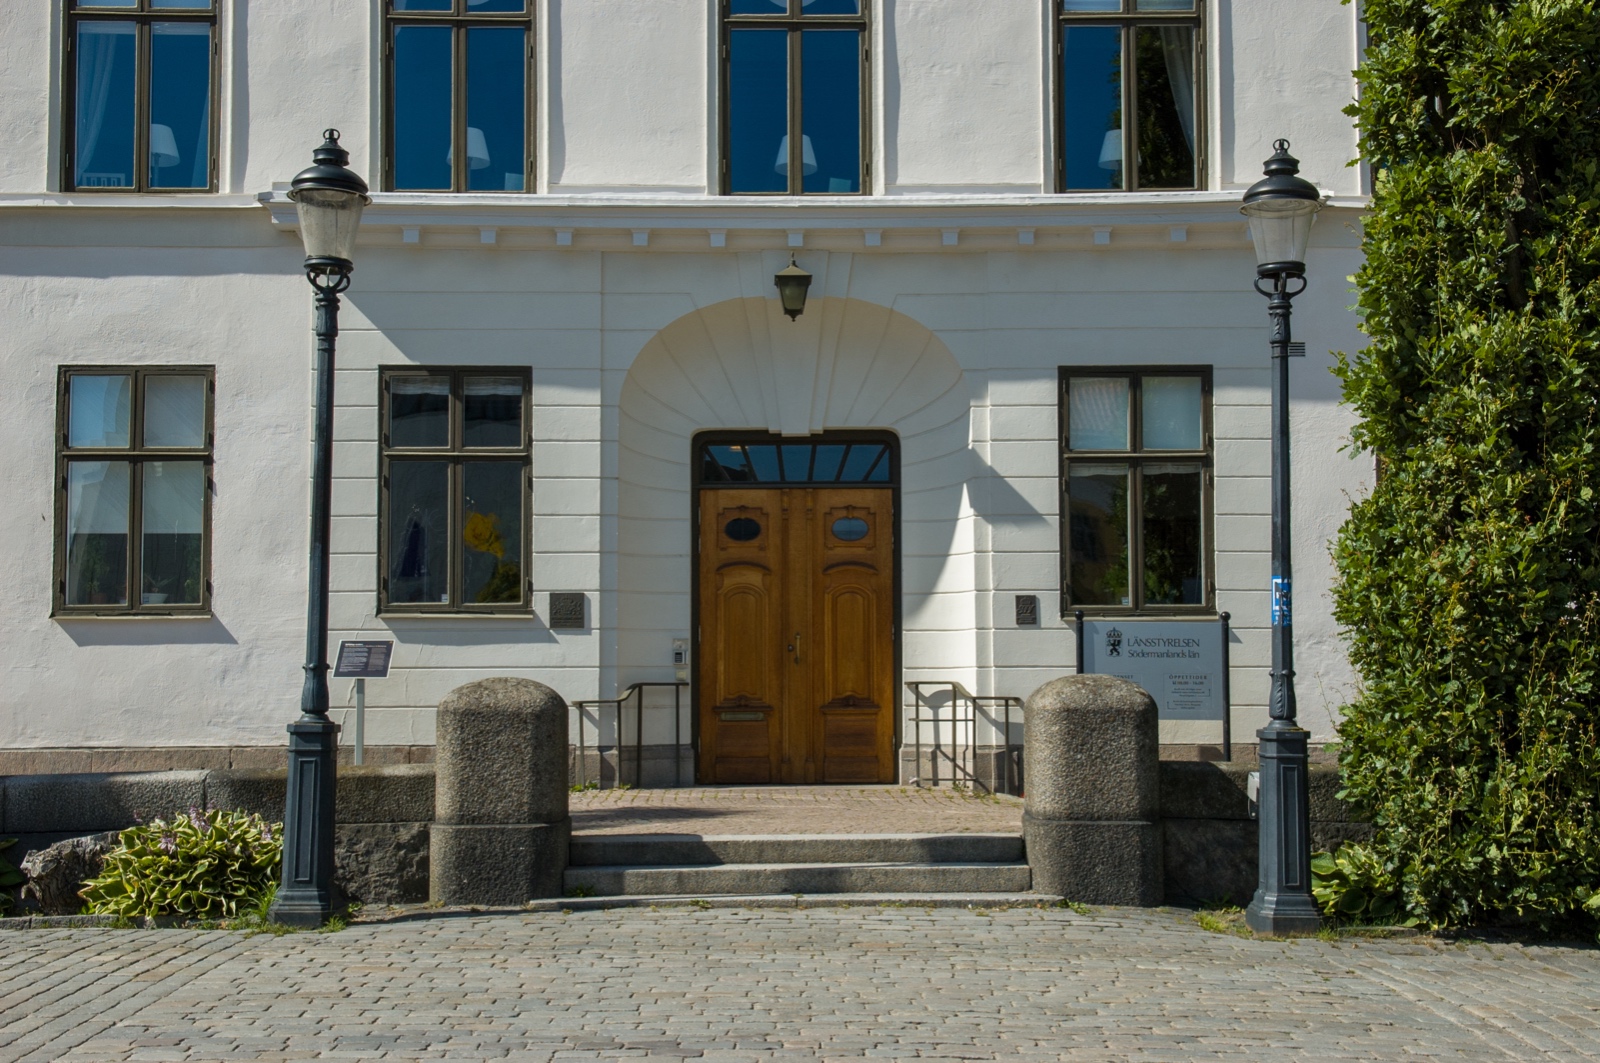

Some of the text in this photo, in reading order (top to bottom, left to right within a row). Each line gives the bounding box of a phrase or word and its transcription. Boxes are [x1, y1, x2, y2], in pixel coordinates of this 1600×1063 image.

[1127, 636, 1200, 648] LÄNSSTYRELSEN
[1128, 649, 1200, 659] Södermanlands län
